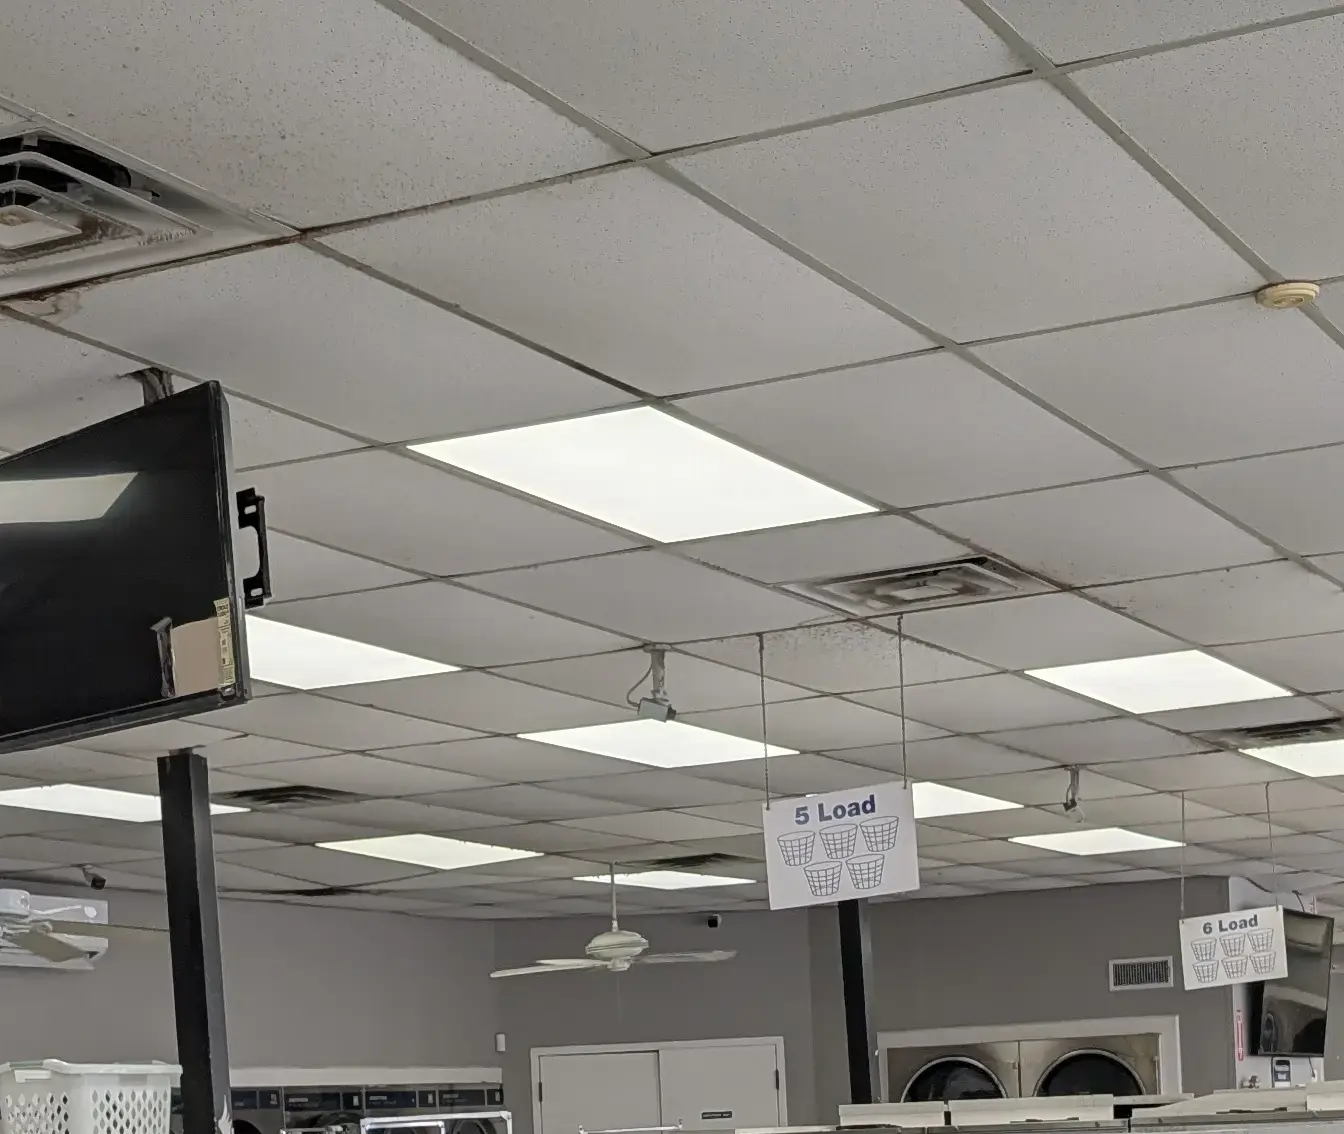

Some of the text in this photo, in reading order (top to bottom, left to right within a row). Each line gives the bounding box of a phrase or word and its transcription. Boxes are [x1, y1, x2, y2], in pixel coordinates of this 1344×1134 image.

[794, 794, 876, 825] 5 Load
[1202, 914, 1258, 935] 6 Load
